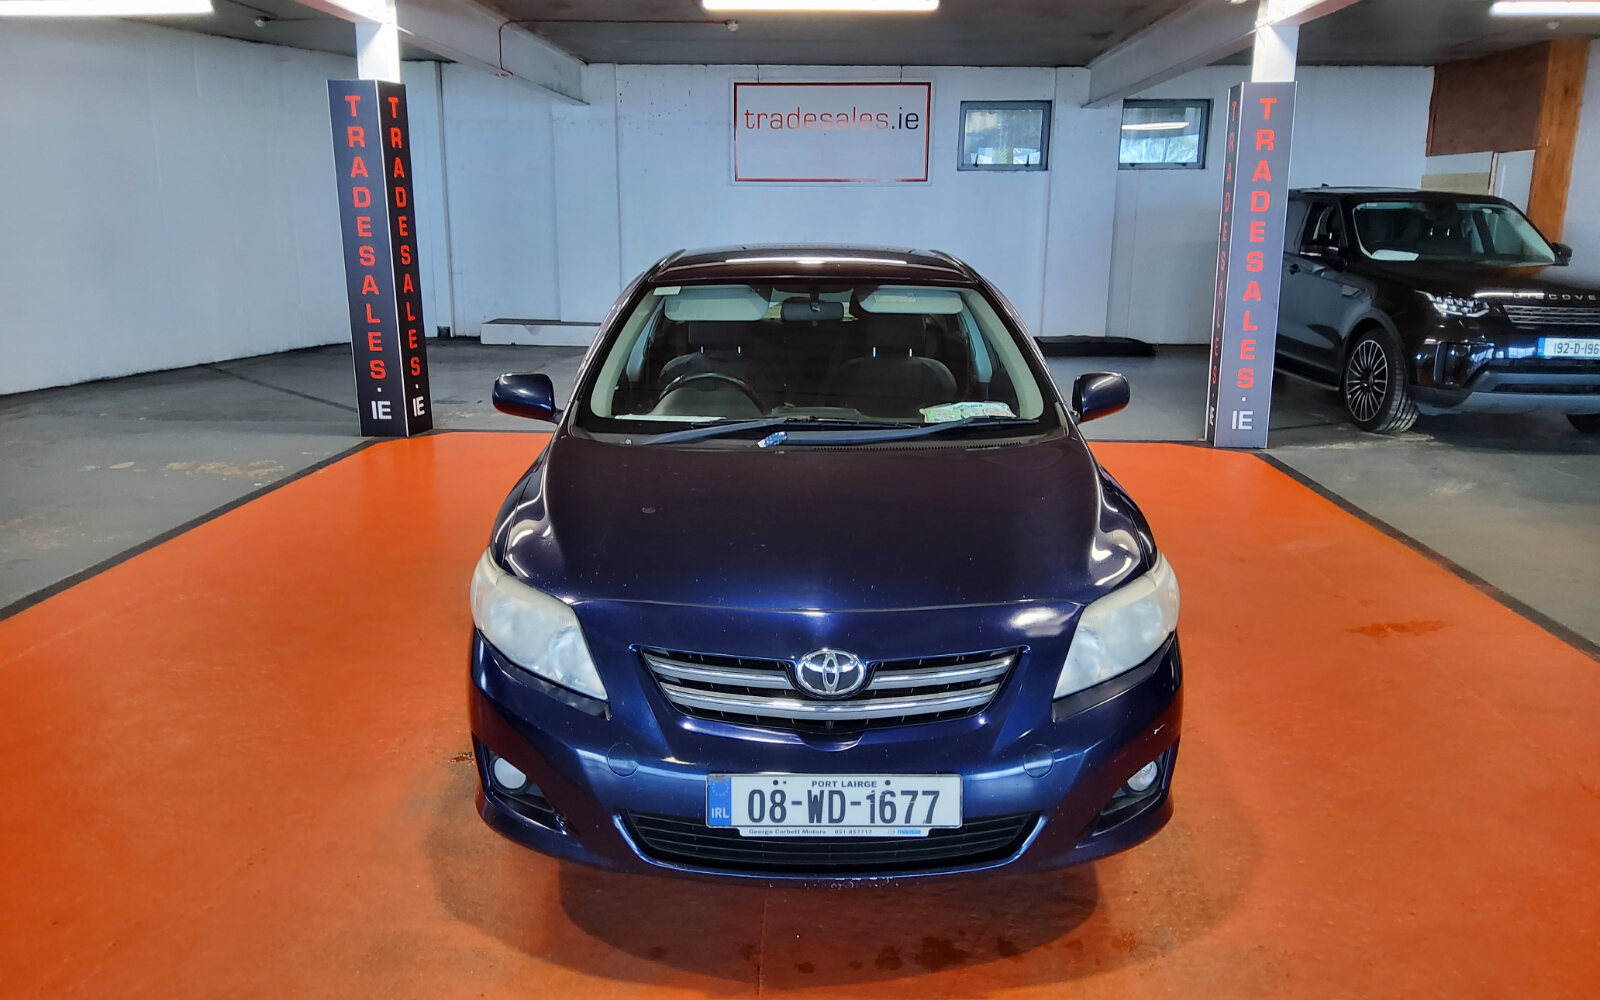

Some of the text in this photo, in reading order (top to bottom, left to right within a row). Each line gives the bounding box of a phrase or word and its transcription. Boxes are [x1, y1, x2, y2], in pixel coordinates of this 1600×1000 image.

[744, 106, 919, 130] tradesales.ie
[344, 95, 392, 420] TRADESALES.IE
[387, 96, 426, 417] TRADESALES.IE
[1231, 97, 1277, 431] TRADESALES.IE
[811, 780, 877, 788] PORT LAIRGE
[711, 807, 730, 819] IRL
[747, 789, 940, 824] 08-WD-1677
